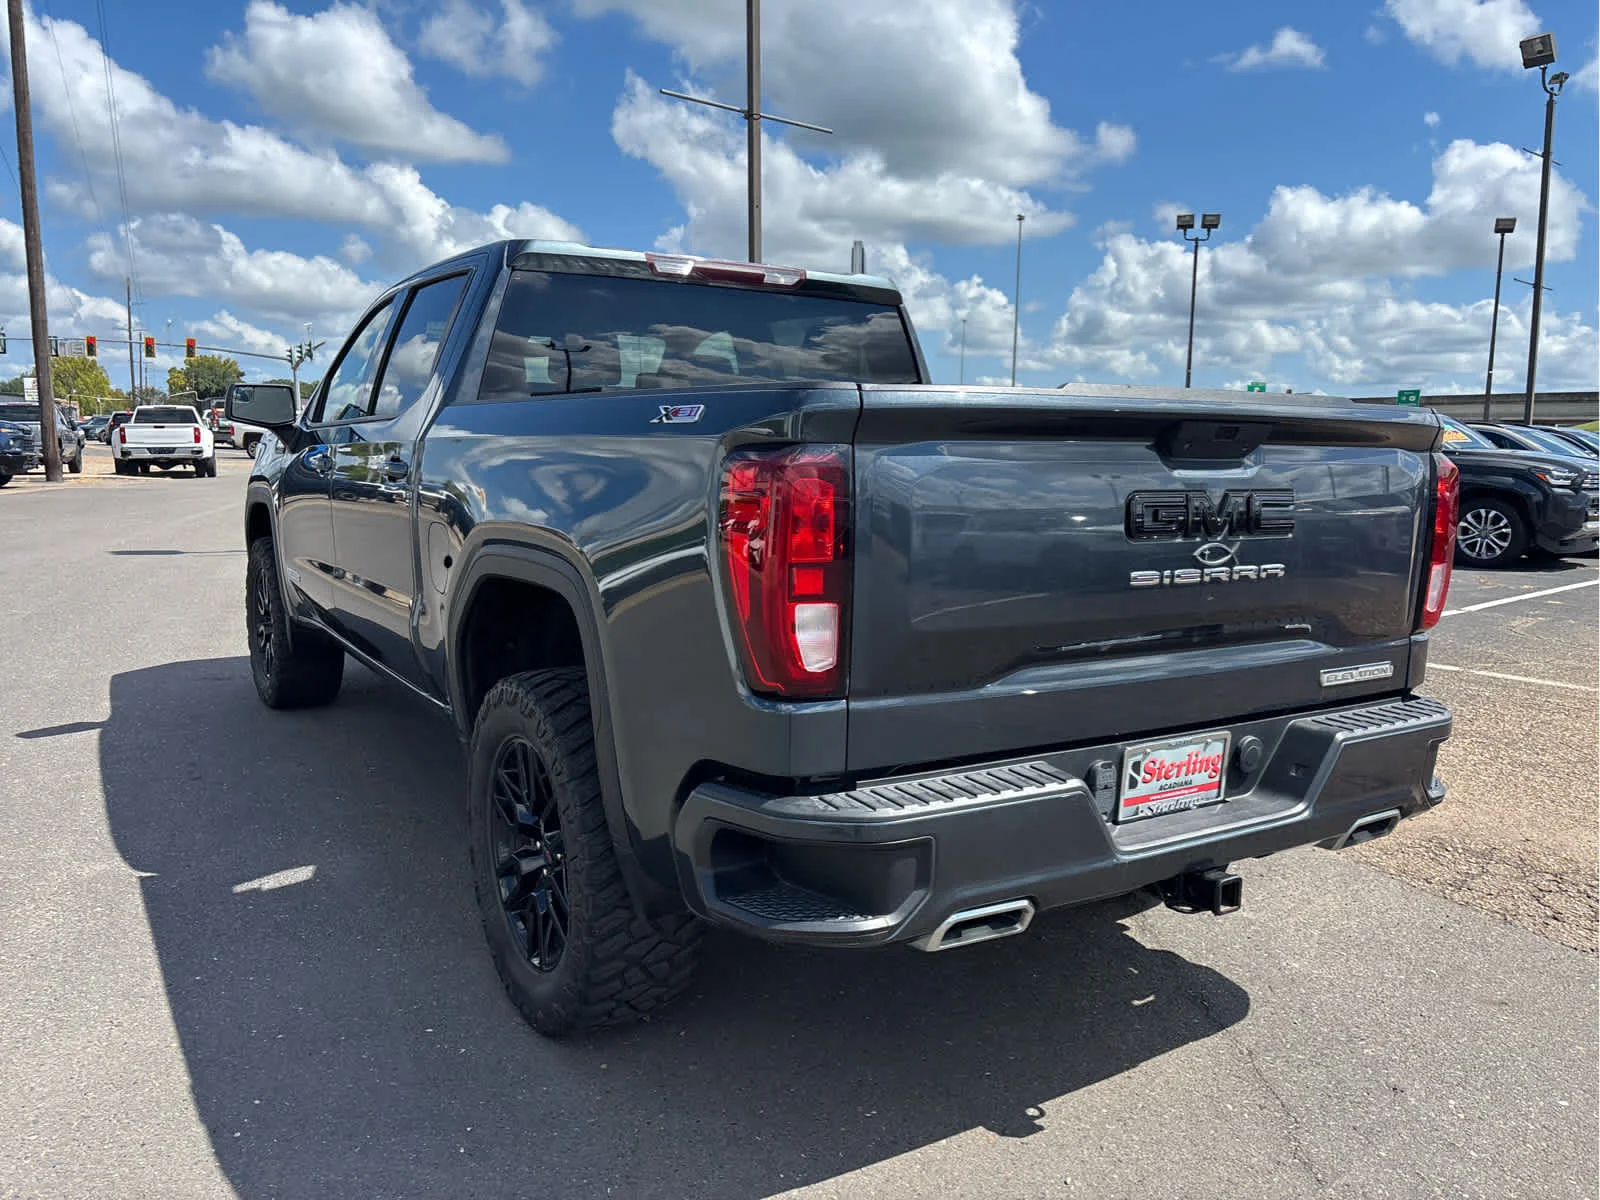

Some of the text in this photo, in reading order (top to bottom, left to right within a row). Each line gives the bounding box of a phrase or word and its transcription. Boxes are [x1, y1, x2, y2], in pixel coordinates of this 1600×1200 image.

[1125, 488, 1296, 542] GMC
[1129, 563, 1286, 587] SIERRA
[1326, 665, 1392, 684] ELEVATION
[1142, 750, 1223, 784] Sterling
[1158, 778, 1193, 792] ACADIANA
